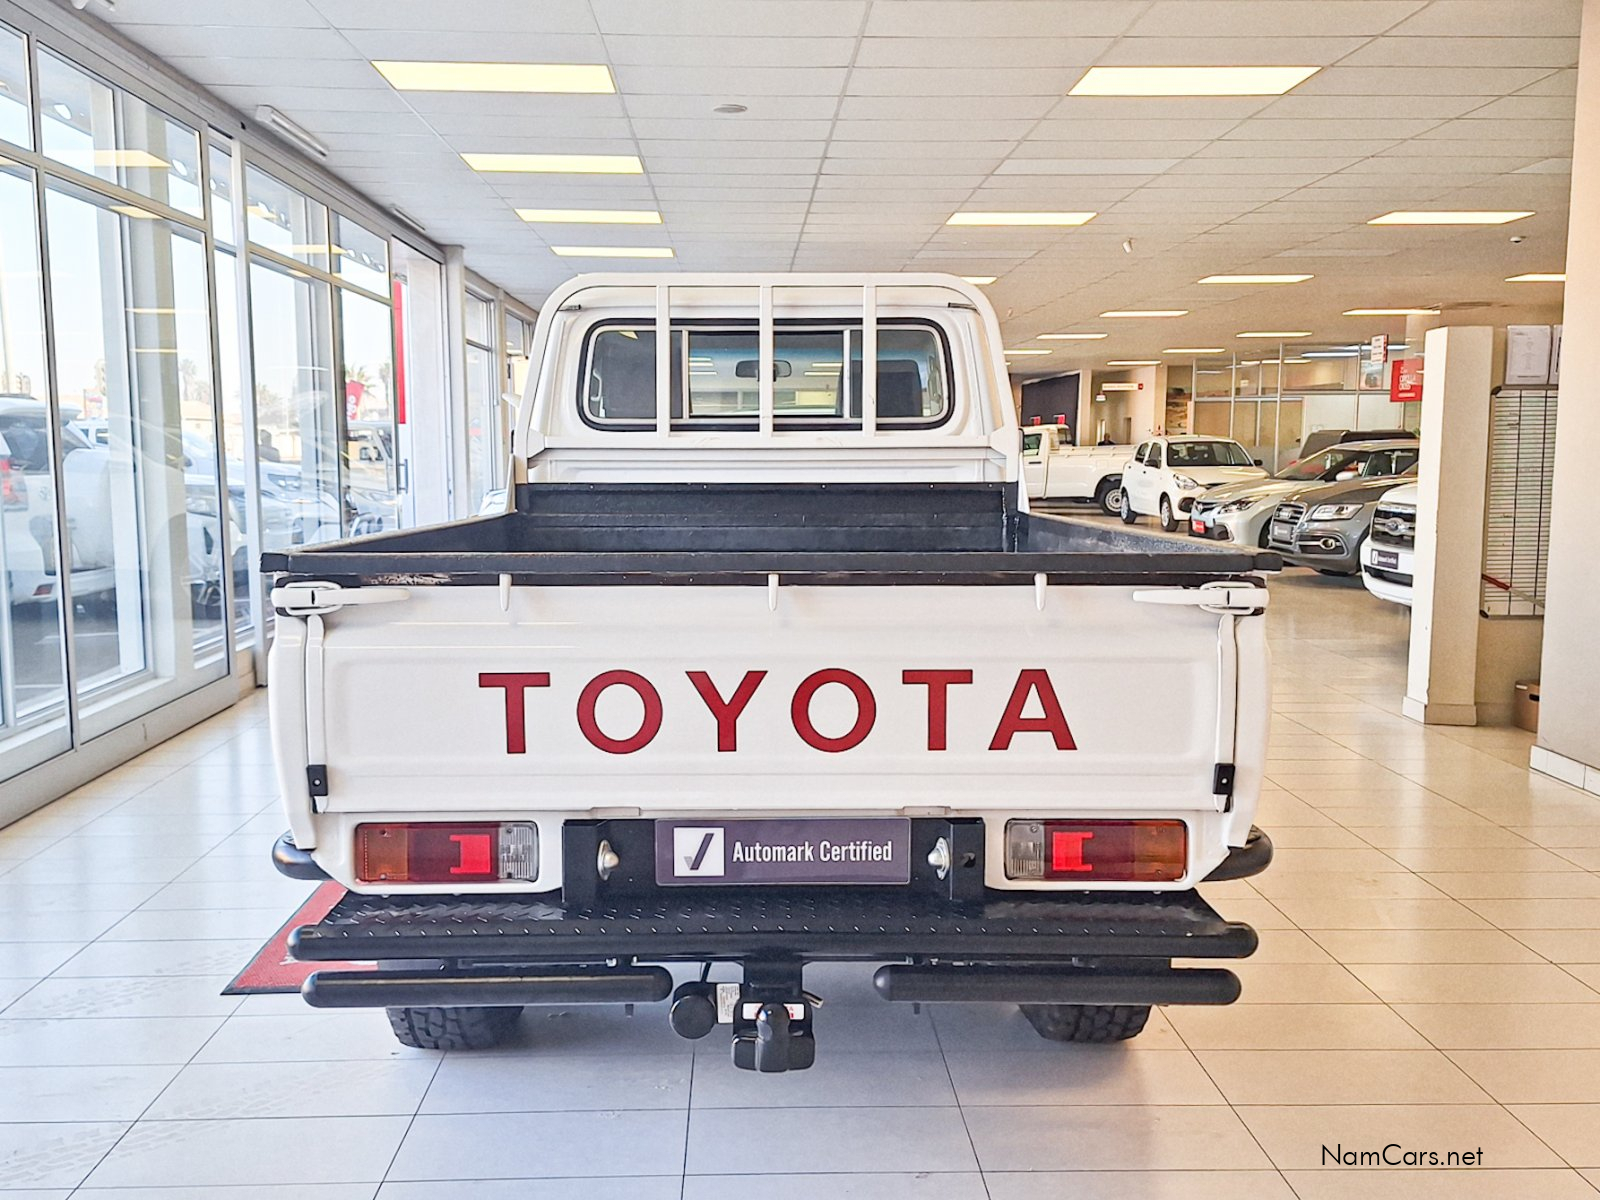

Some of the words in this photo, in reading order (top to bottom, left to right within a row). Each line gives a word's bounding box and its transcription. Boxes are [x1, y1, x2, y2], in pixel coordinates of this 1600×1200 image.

[479, 668, 1077, 753] TOYOTA
[733, 842, 813, 861] Automark
[820, 841, 891, 861] Certified
